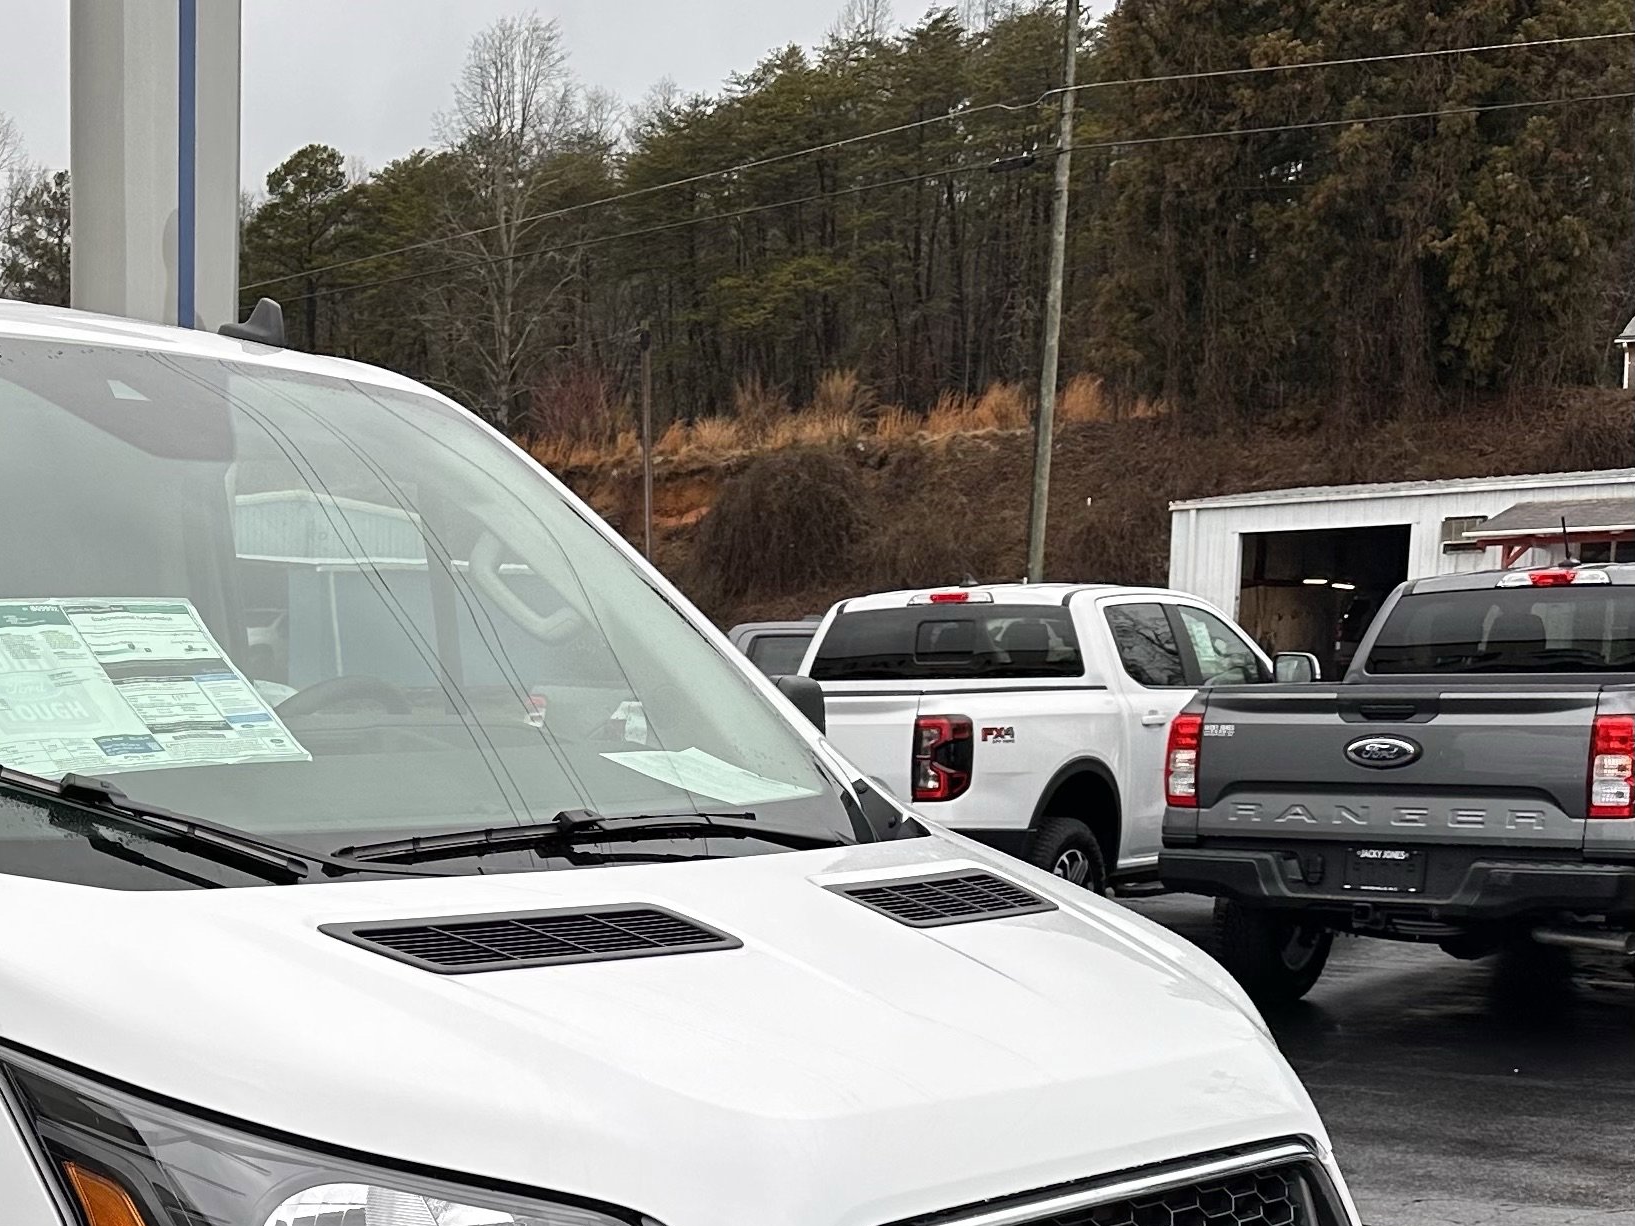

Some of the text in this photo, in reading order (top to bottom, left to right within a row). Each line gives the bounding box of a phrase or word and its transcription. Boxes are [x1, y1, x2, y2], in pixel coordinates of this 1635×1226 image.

[981, 726, 1015, 742] FX4
[1362, 743, 1399, 759] Ford
[1228, 801, 1546, 831] RANGER
[1360, 849, 1405, 860] JACKY JONES
